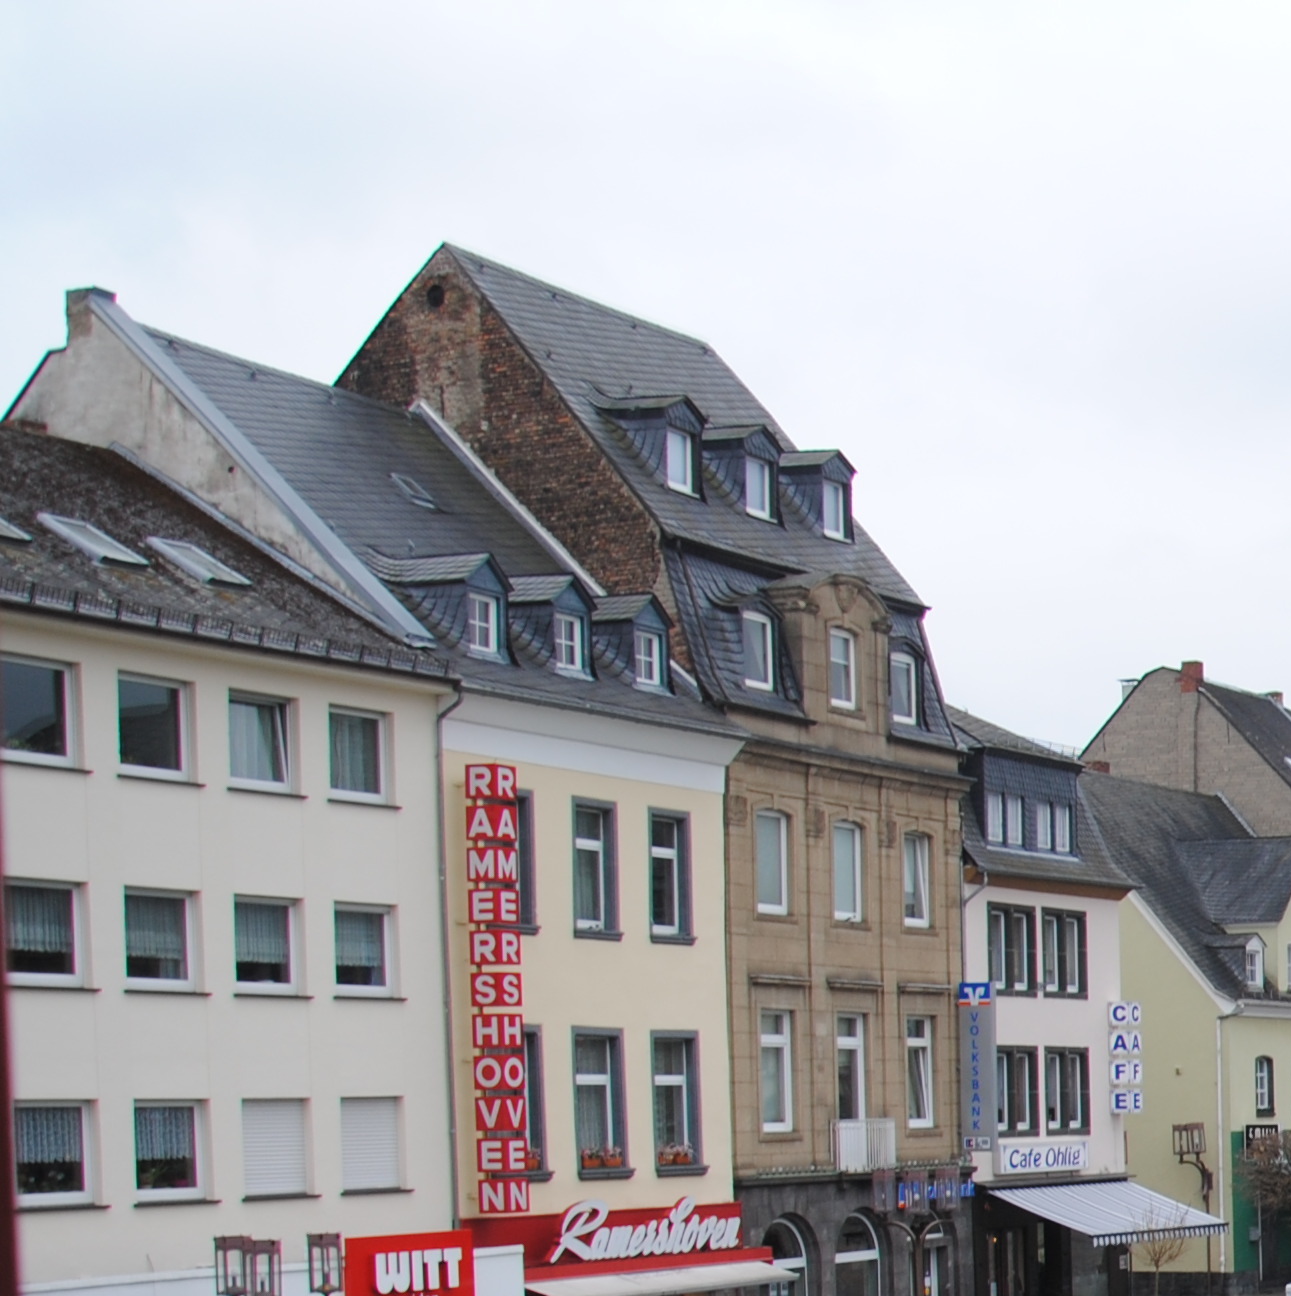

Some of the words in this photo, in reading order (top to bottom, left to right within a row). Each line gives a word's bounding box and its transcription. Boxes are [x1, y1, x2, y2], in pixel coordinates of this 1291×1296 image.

[467, 765, 505, 1211] RAMERSHOVEN
[496, 765, 529, 1211] RAMERSHOVEN
[970, 1012, 981, 1130] VOLKSBANK
[1112, 1005, 1128, 1110] CAFE
[1131, 1006, 1140, 1110] CAFE
[1009, 1149, 1041, 1168] Cafe
[1046, 1147, 1081, 1167] Ohlig
[375, 1248, 462, 1295] WITT
[550, 1197, 741, 1264] Ramershoven
